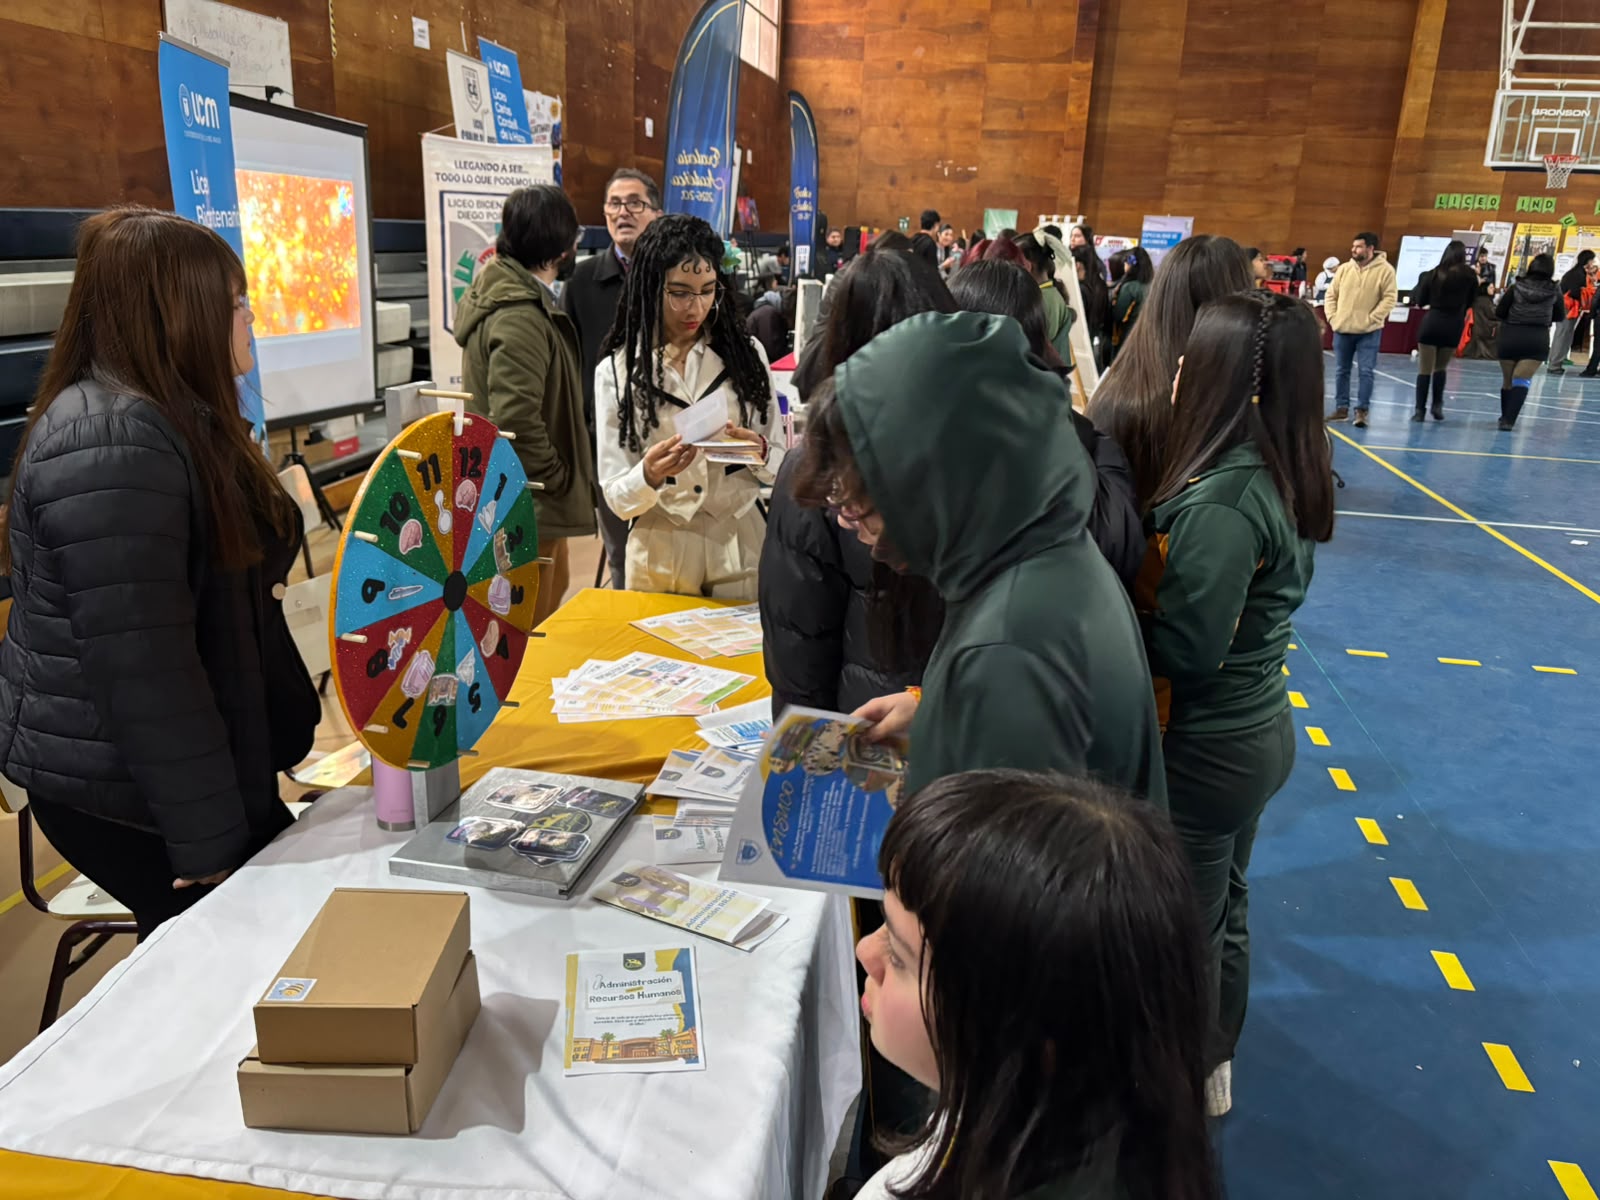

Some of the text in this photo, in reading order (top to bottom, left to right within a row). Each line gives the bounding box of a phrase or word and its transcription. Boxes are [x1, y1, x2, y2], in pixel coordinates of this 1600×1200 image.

[1531, 108, 1590, 117] BRONSON
[454, 160, 499, 172] LLEGANDO
[501, 163, 507, 173] A
[435, 172, 460, 183] TODO
[462, 174, 473, 184] LO
[475, 174, 492, 184] QUE
[447, 198, 475, 209] LICEO
[1438, 196, 1554, 209] LICEO IND
[457, 210, 484, 220] DIEGO
[458, 445, 482, 478] 12
[416, 453, 442, 491] 11
[380, 491, 411, 535] 10
[366, 648, 389, 678] 8
[685, 888, 729, 930] Administración
[694, 904, 720, 931] mención
[600, 976, 672, 989] Administración
[589, 993, 635, 1003] Recursos
[637, 988, 682, 1000] Humanos
